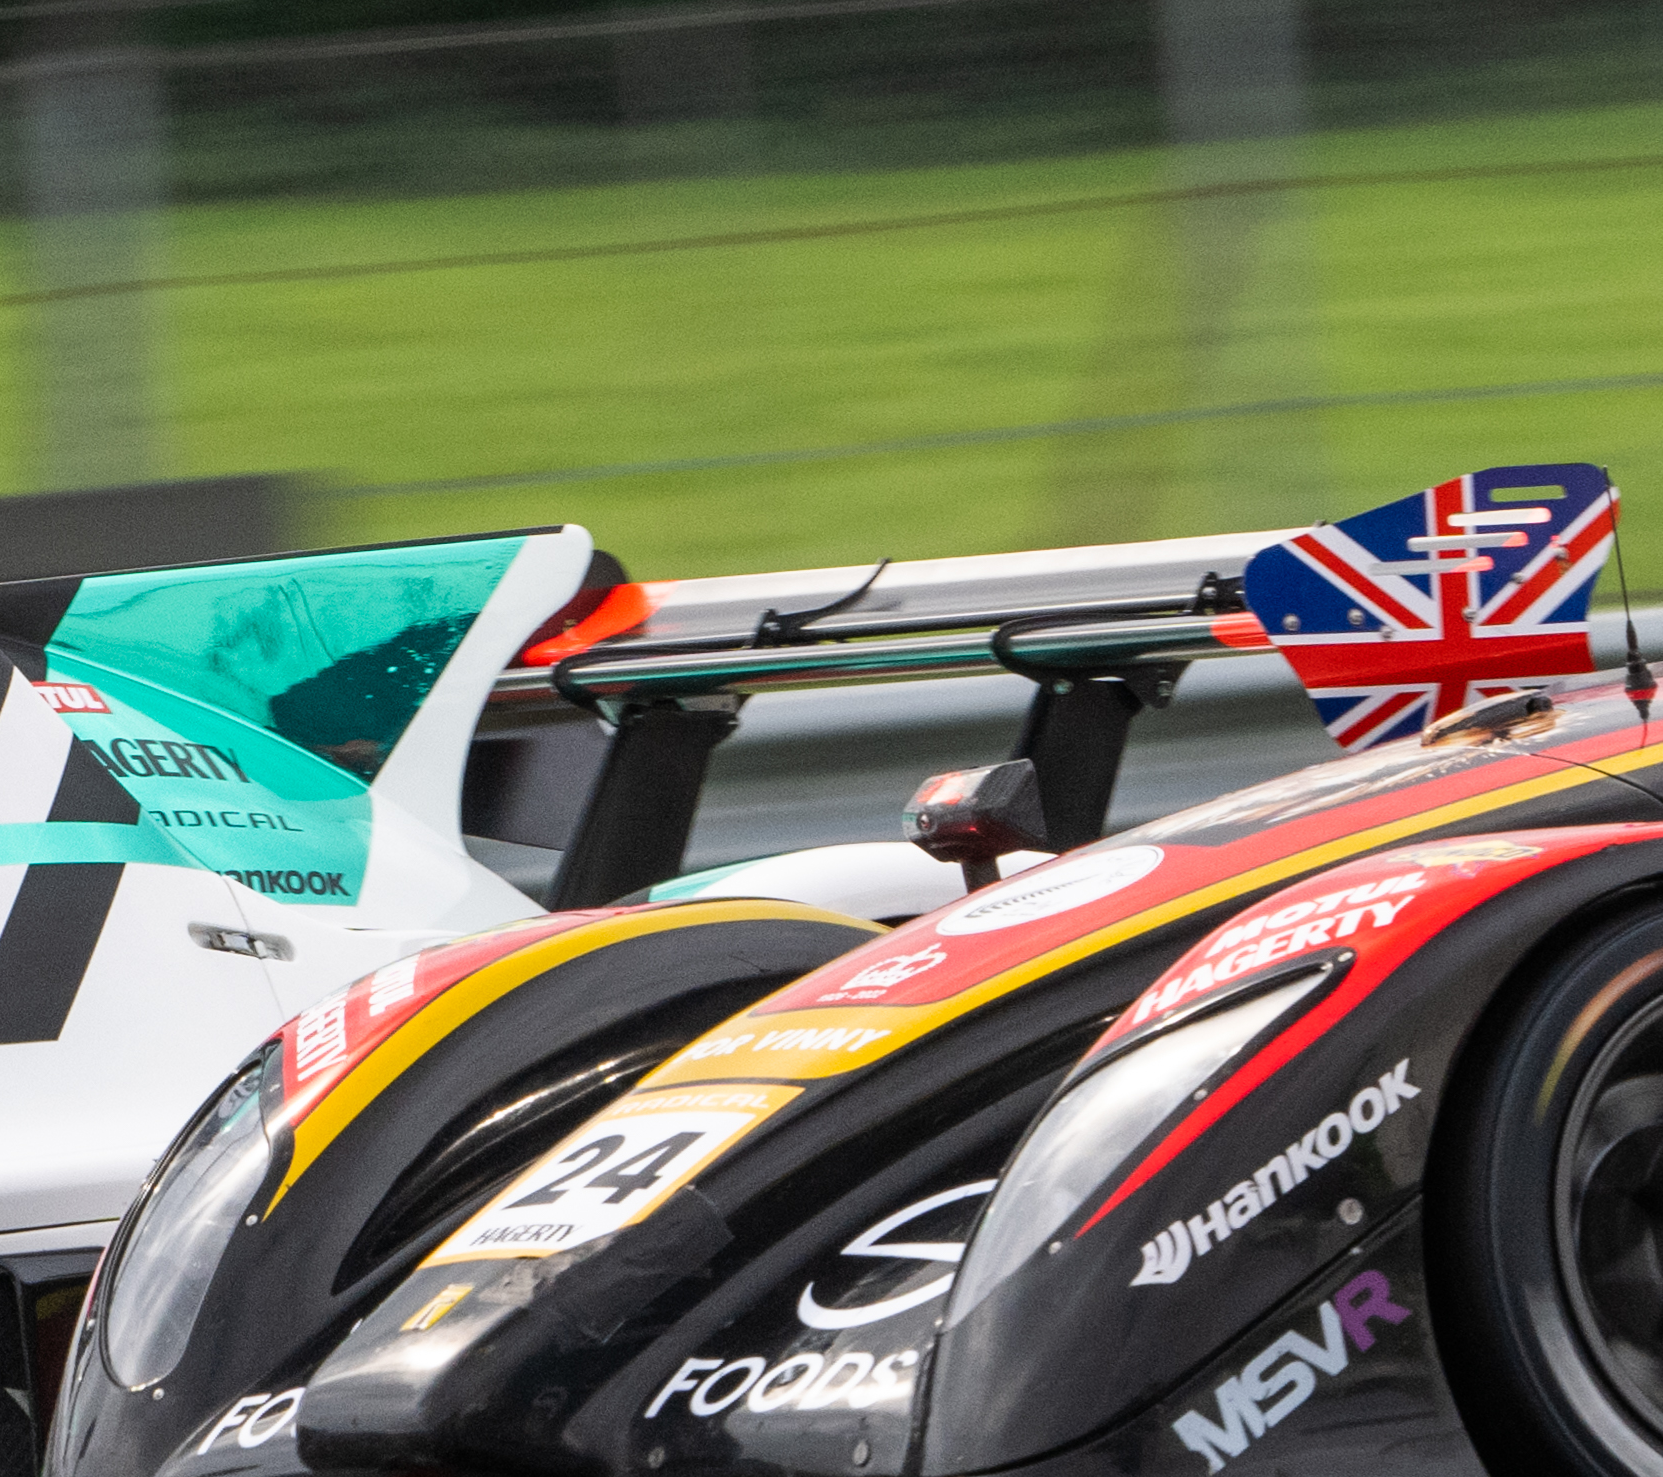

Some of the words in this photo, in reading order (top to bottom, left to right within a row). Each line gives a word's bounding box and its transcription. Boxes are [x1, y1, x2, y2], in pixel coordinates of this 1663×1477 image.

[41, 686, 105, 709] TUL
[80, 738, 251, 783] AGERTY
[149, 809, 305, 832] ADICAL
[1204, 871, 1428, 959] MOTUL
[1132, 895, 1415, 1024] HAGERTY
[753, 1028, 892, 1052] VINNY
[611, 1093, 770, 1117] RADICAL
[502, 1131, 707, 1210] 24
[471, 1224, 583, 1246] HAGERTY
[645, 1350, 919, 1418] FOODS
[1173, 1270, 1412, 1476] MSVR
